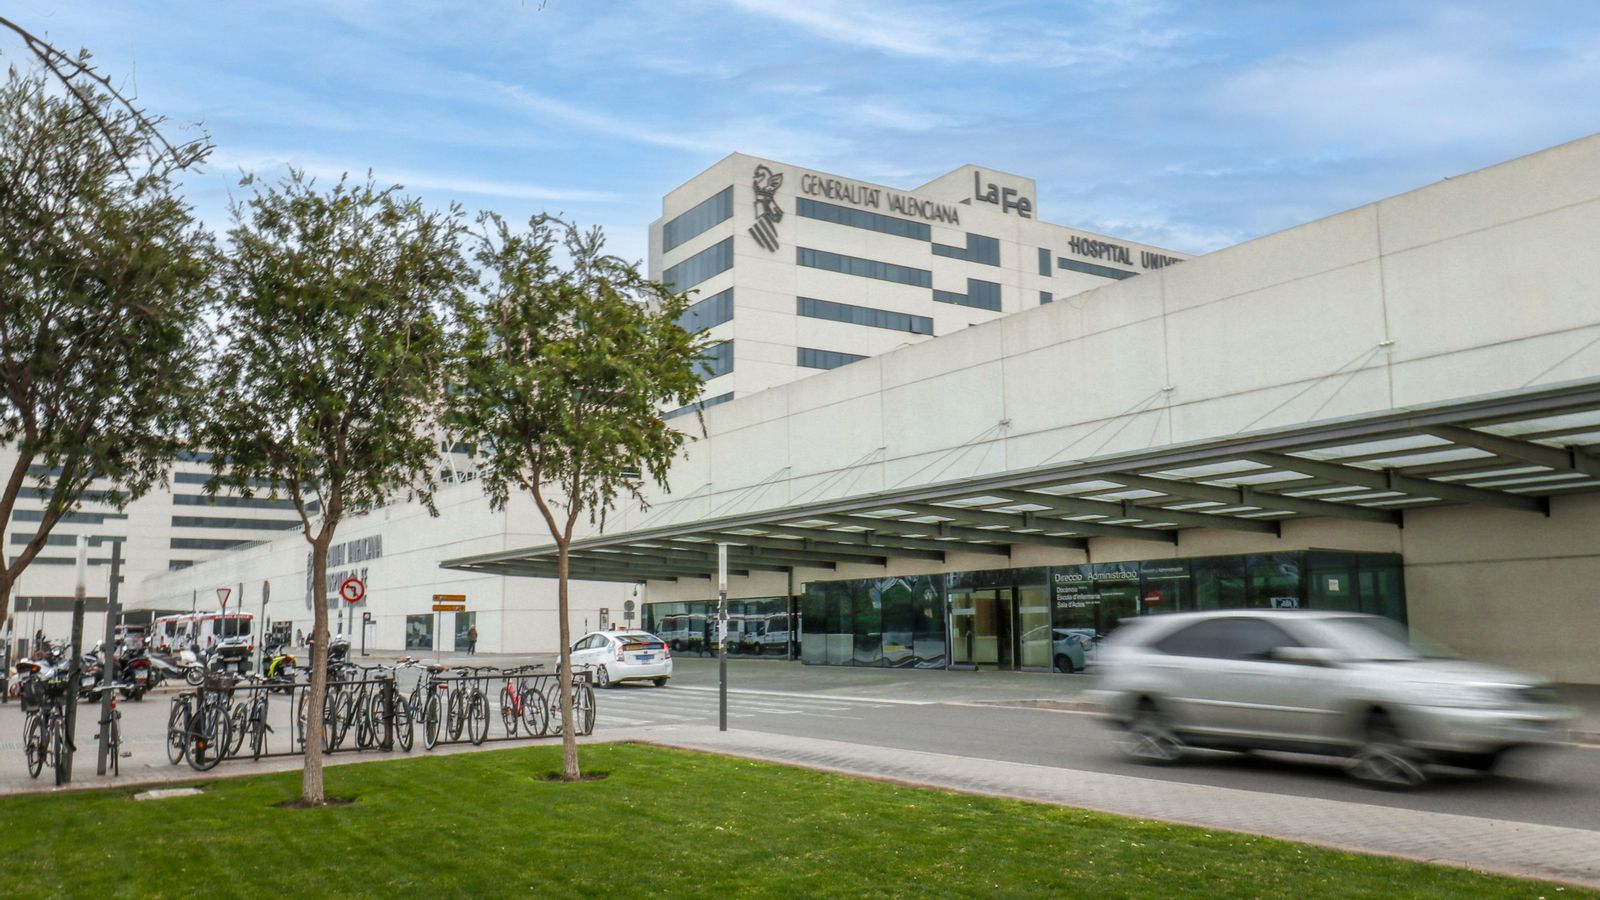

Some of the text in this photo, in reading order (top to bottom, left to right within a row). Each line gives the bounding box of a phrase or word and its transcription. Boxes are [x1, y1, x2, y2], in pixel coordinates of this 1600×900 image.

[801, 173, 960, 226] GENERALITAT VALENCIANA
[1068, 235, 1134, 266] HOSPITAL
